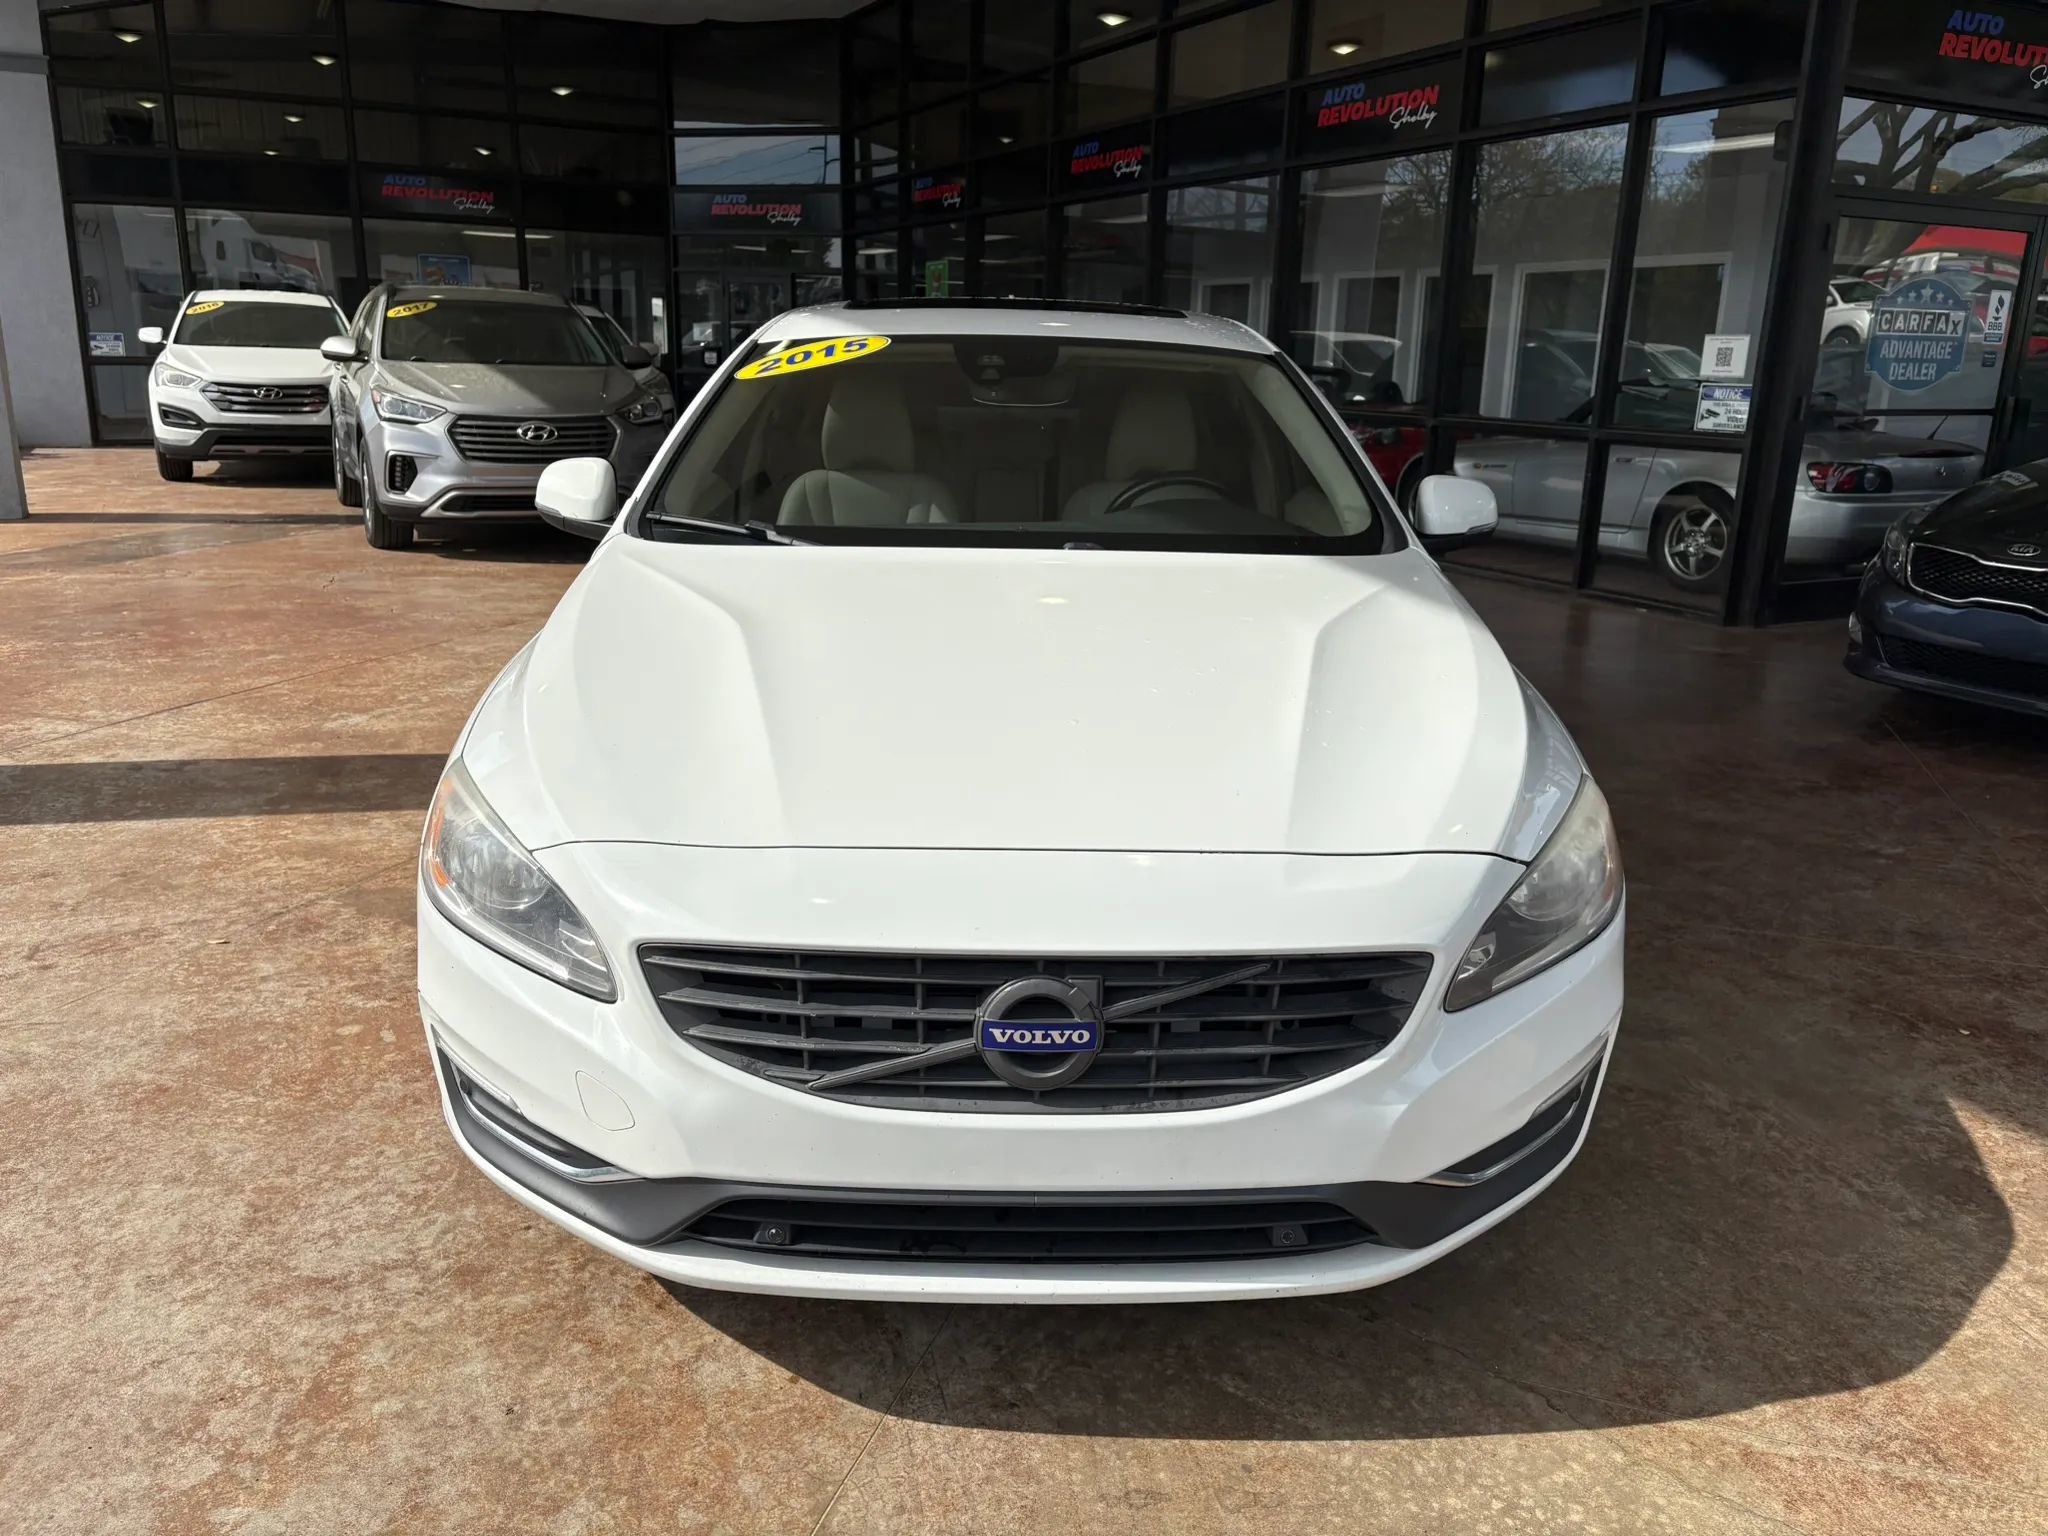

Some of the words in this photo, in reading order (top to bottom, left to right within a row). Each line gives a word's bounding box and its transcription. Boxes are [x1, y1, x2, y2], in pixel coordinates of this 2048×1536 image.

[1946, 9, 2005, 35] AUTO
[1322, 82, 1365, 106] AUTO
[1317, 84, 1439, 127] REVOLUTION
[1389, 101, 1437, 129] Shelby
[1072, 141, 1099, 158] AUTO
[384, 175, 426, 186] AUTO
[382, 185, 494, 203] REVOLUTION
[713, 194, 747, 204] AUTO
[453, 197, 495, 214] Shelby
[711, 203, 801, 215] REVOLUTION
[392, 302, 429, 315] 2017
[1881, 313, 1960, 335] CARFAX
[755, 338, 869, 376] 2015
[1880, 339, 1953, 359] ADVANTAGE
[1889, 362, 1937, 381] DEALER
[1713, 387, 1744, 400] NOTICE
[989, 1028, 1091, 1044] VOLVO
